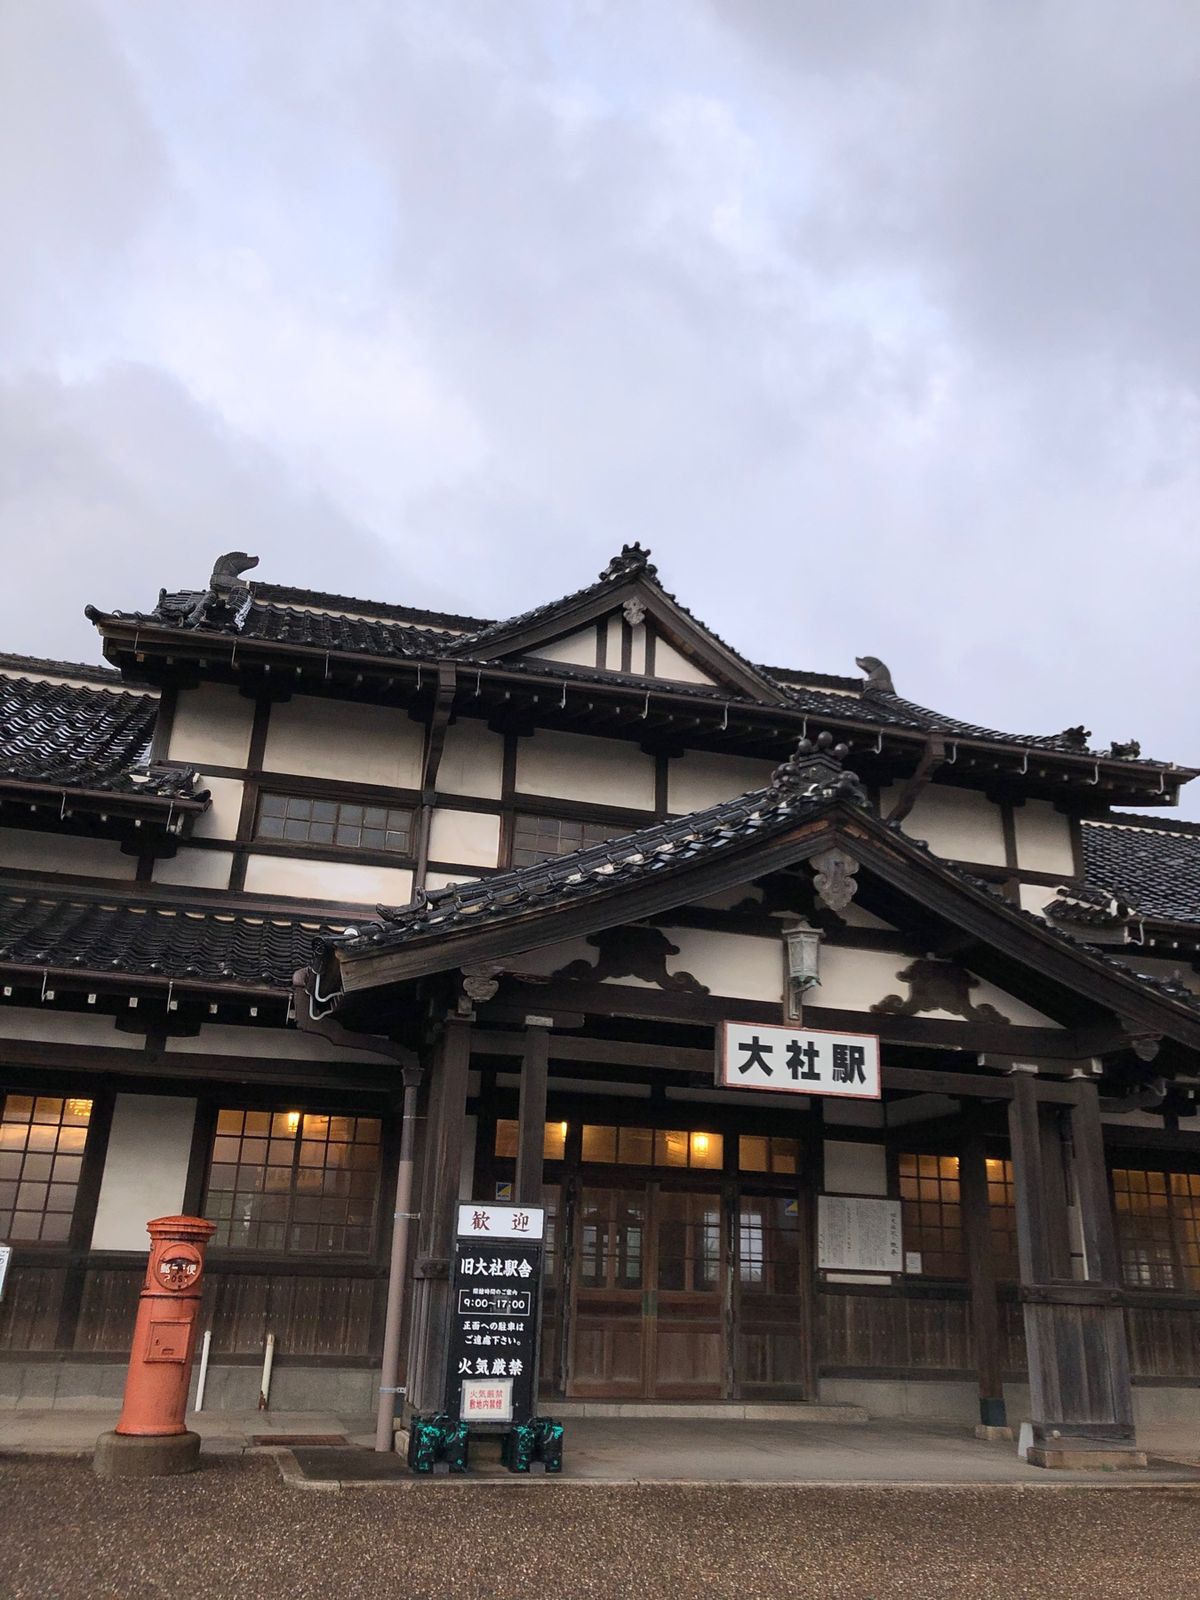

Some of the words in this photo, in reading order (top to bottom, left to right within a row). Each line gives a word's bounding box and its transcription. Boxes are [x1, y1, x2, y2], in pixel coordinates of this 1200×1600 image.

[738, 1035, 867, 1085] 大社駅
[470, 1210, 531, 1233] 歓迎
[460, 1257, 533, 1278] 旧大社駅舎
[462, 1321, 525, 1332] 正面への駐車は
[457, 1357, 524, 1376] 火気厳禁
